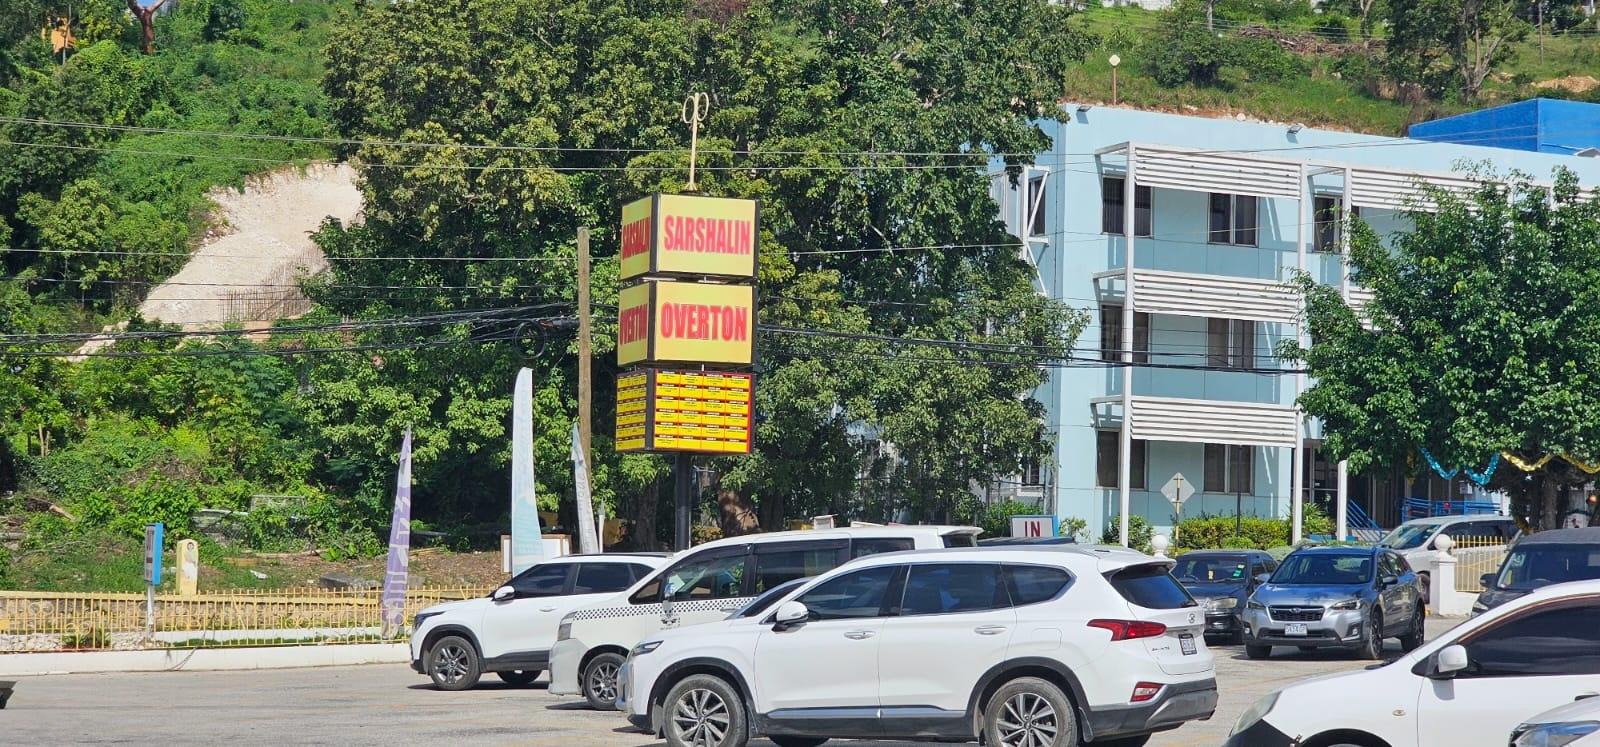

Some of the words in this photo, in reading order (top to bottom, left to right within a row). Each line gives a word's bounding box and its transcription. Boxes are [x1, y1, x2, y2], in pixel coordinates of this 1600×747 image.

[664, 215, 750, 255] SARSHALIN
[661, 302, 747, 341] OVERTON
[1024, 520, 1041, 537] IN
